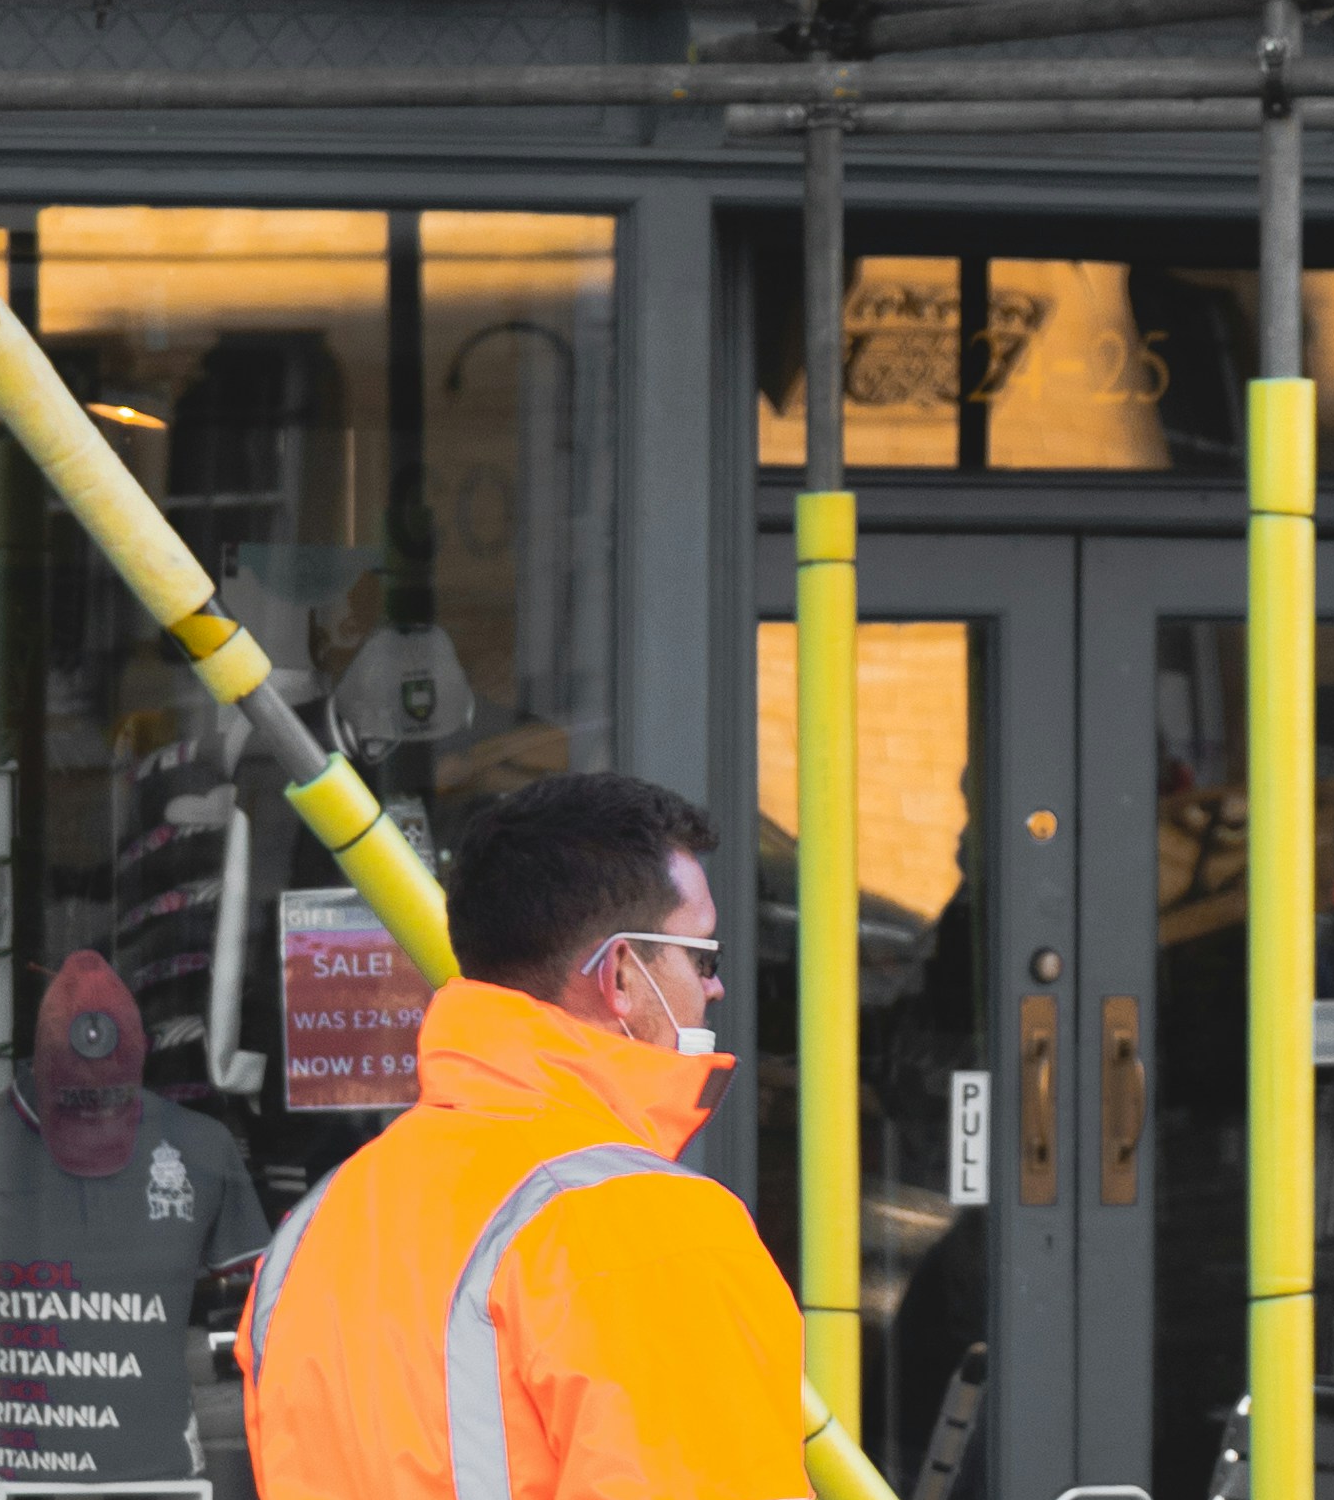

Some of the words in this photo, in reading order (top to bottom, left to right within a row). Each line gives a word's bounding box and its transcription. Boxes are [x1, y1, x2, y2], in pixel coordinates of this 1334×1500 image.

[970, 329, 1170, 401] 24-25
[313, 952, 393, 978] SALE!
[293, 1011, 346, 1030] WAS
[353, 1007, 424, 1030] £24.99
[292, 1056, 353, 1077] NOW
[381, 1053, 417, 1076] 9.9
[961, 1082, 981, 1193] PULL
